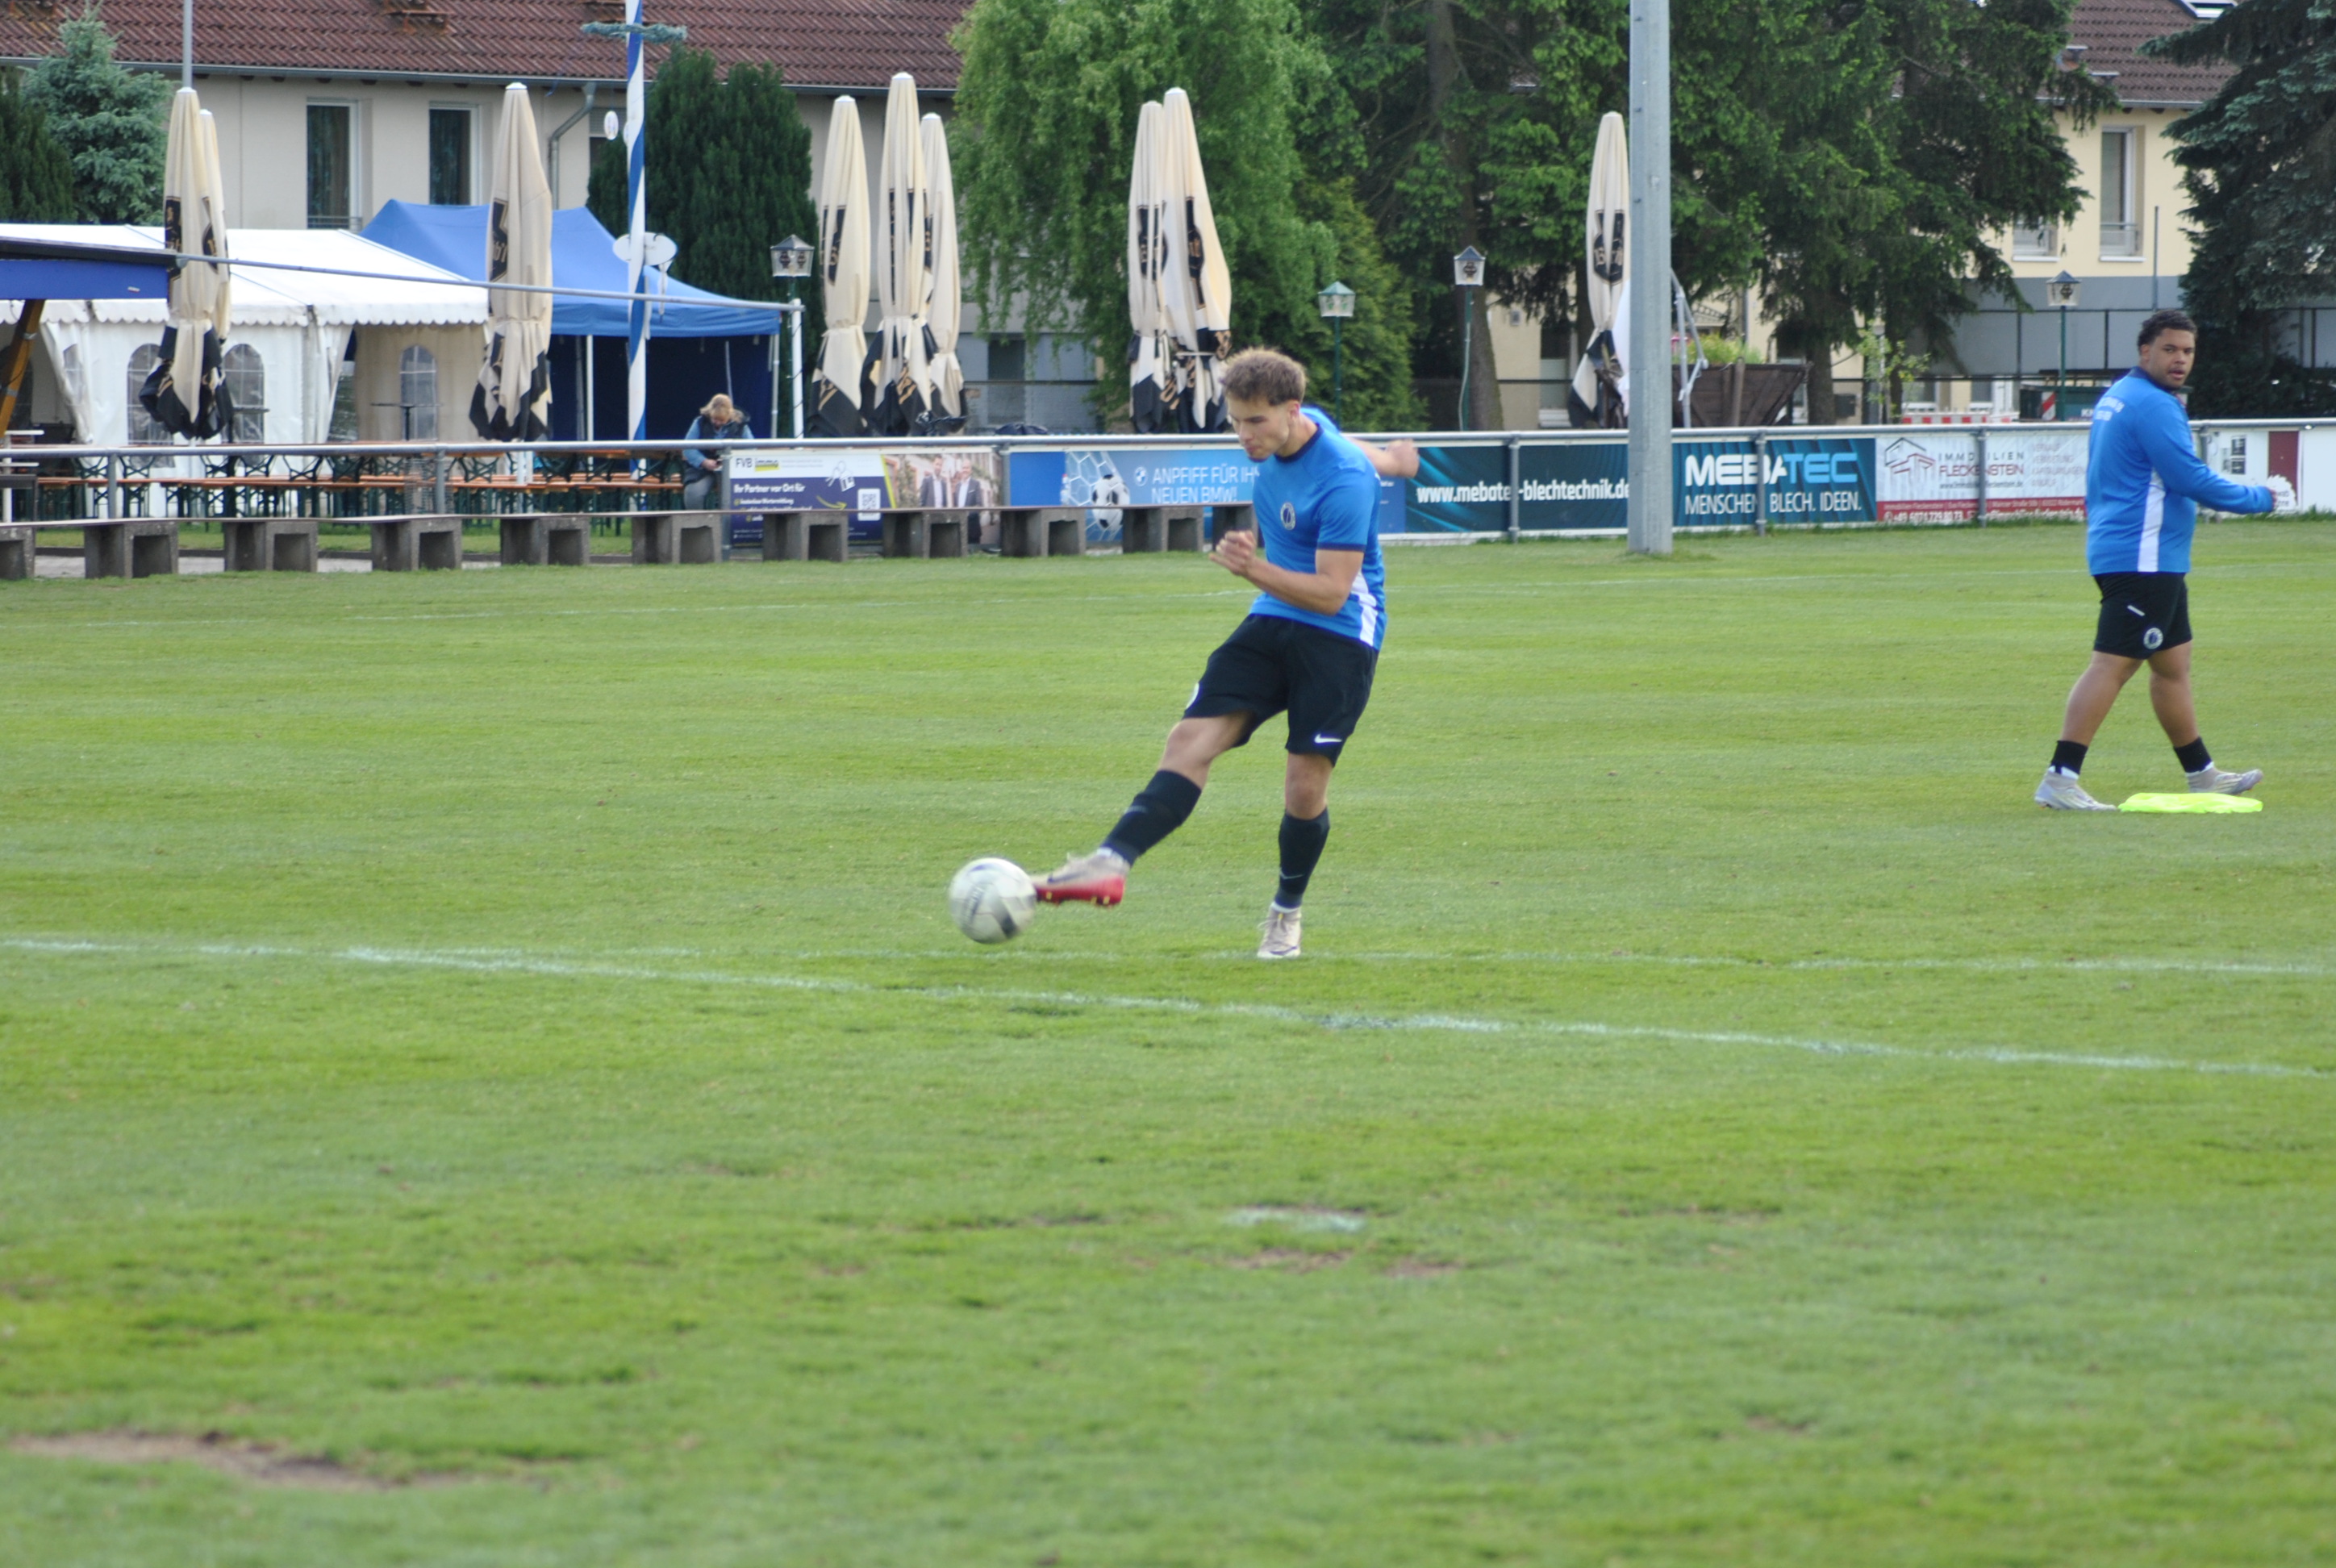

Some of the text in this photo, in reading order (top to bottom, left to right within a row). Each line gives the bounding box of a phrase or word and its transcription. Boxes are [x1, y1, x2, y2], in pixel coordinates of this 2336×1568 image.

[736, 457, 753, 468] FVB
[1938, 451, 2024, 461] IMMOILIEN
[1153, 467, 1208, 484] ANPFIFF
[1212, 463, 1239, 484] FÜR
[745, 483, 770, 493] Partner
[782, 482, 795, 493] Ort
[795, 482, 806, 492] für
[1151, 486, 1237, 504] NEUEN BMW!
[1417, 478, 1629, 503] www.mebate-blechtechnik.de
[1770, 491, 1816, 512] BLECH.
[1820, 490, 1862, 511] IDEEN.
